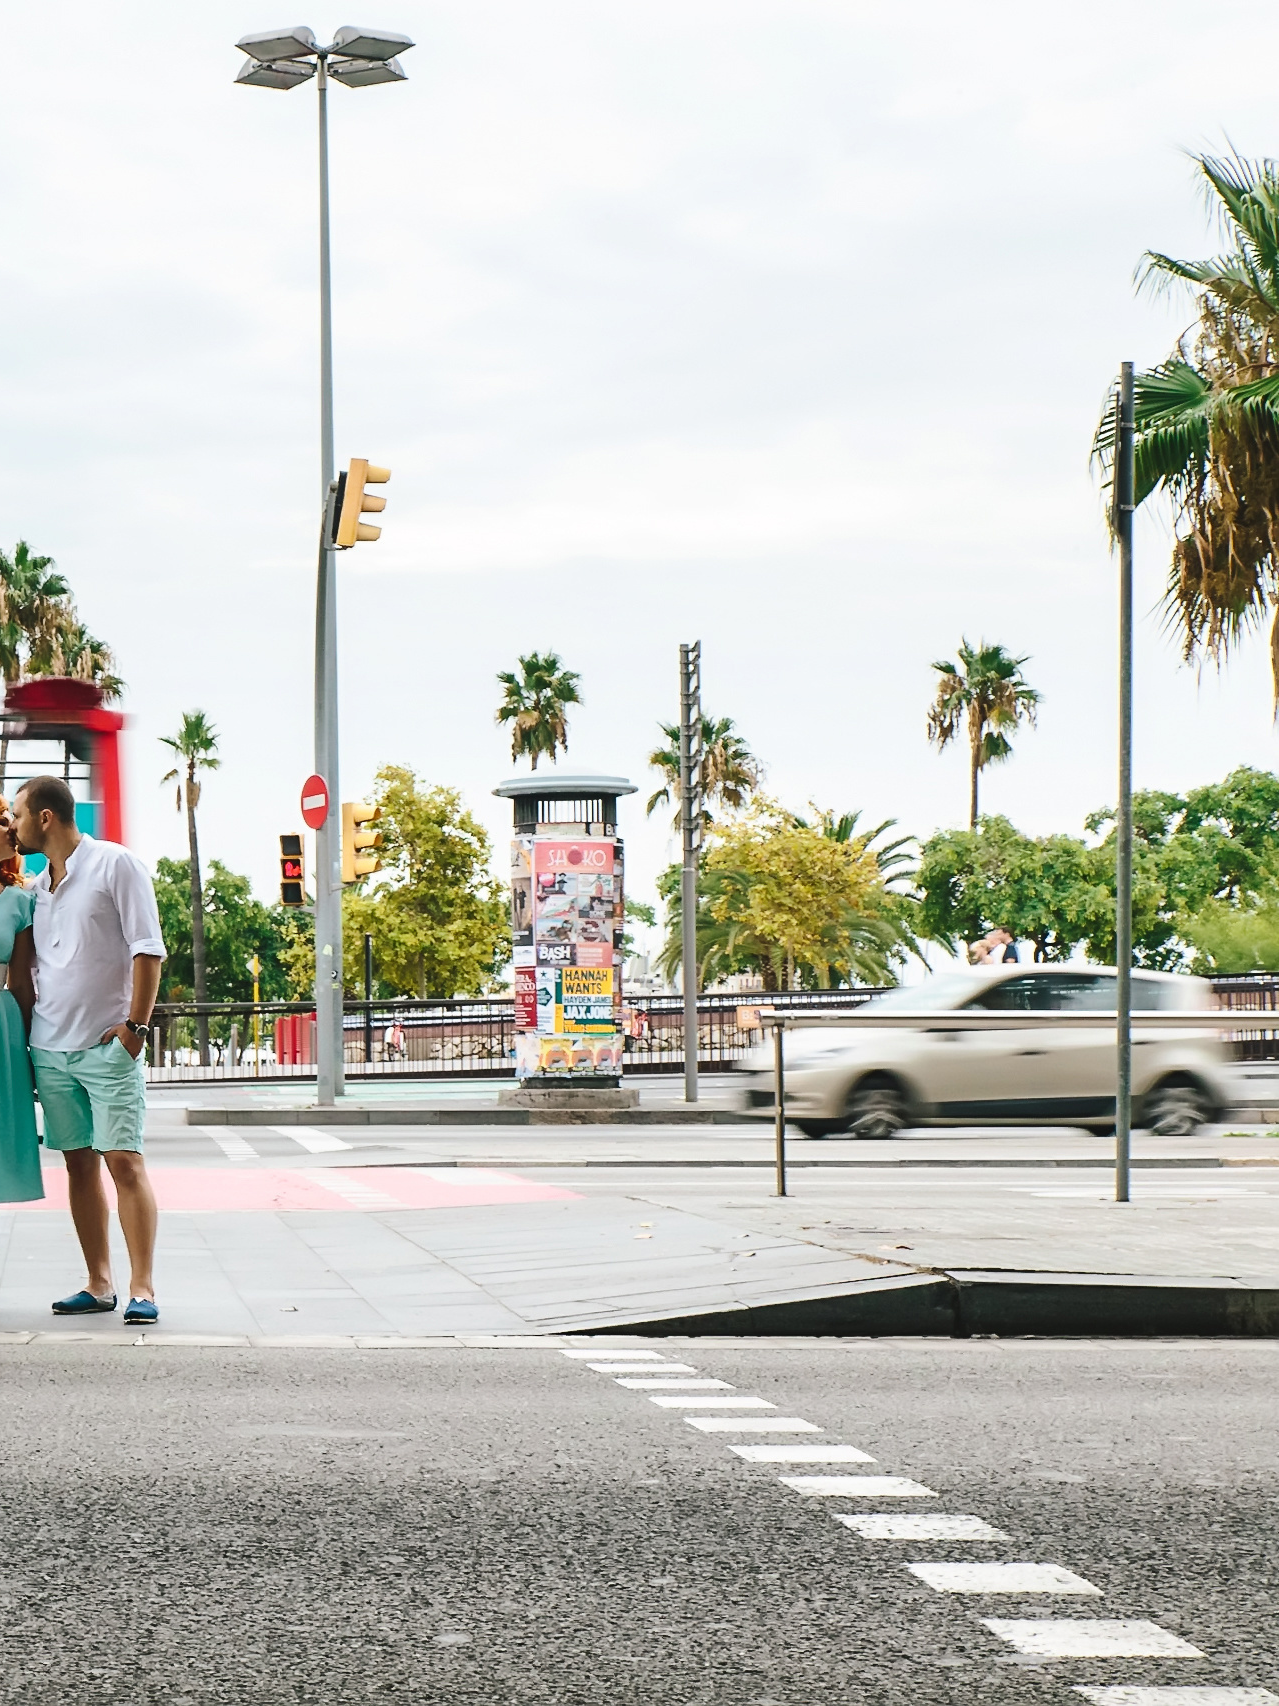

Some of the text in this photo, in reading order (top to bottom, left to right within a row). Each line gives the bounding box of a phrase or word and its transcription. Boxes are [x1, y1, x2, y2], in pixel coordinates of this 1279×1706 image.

[539, 946, 571, 961] BASH
[565, 969, 608, 982] HANNAH
[565, 982, 602, 995] WANTS
[564, 1005, 587, 1020] JAX
